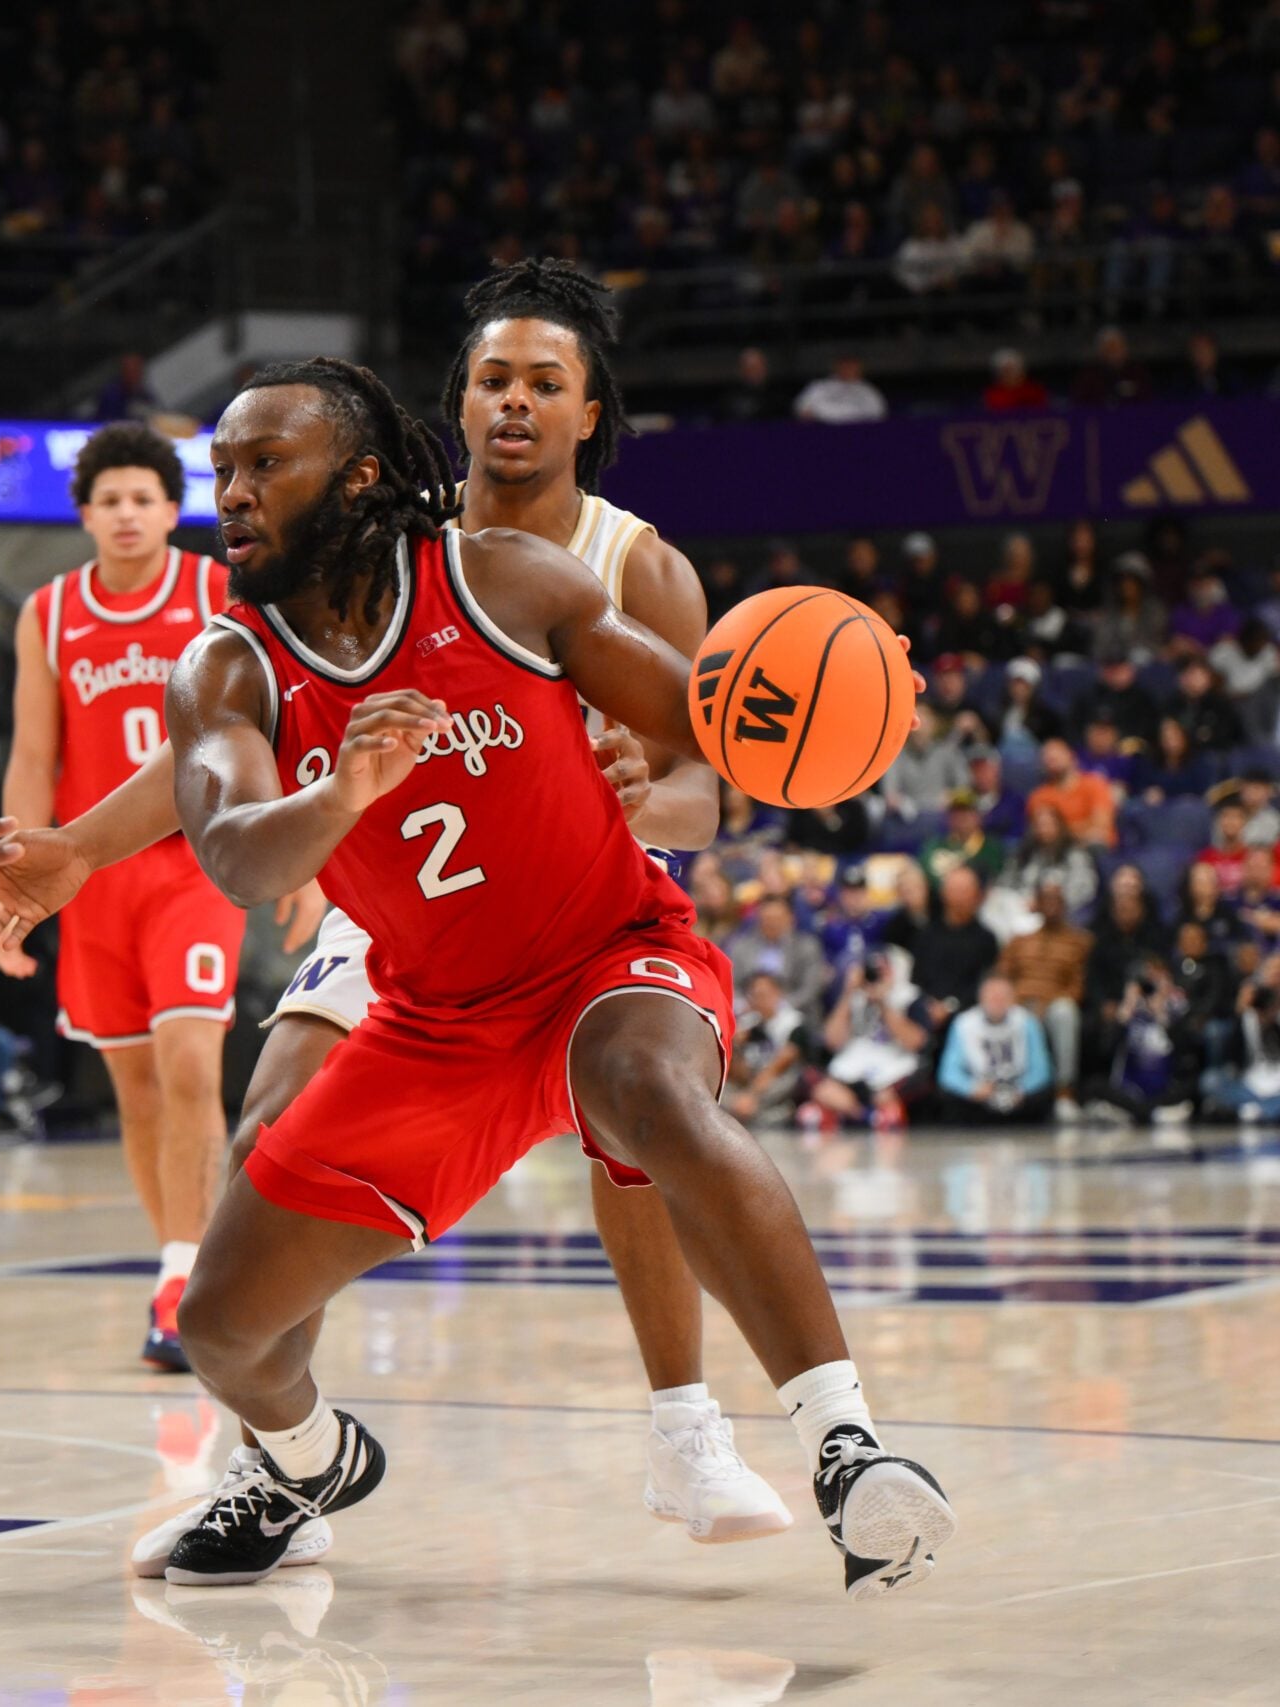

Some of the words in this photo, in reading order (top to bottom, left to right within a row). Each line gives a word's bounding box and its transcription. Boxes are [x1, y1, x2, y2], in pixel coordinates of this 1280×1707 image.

[941, 420, 1069, 517] W
[123, 706, 163, 766] 0
[732, 666, 798, 744] W
[399, 801, 487, 901] 2
